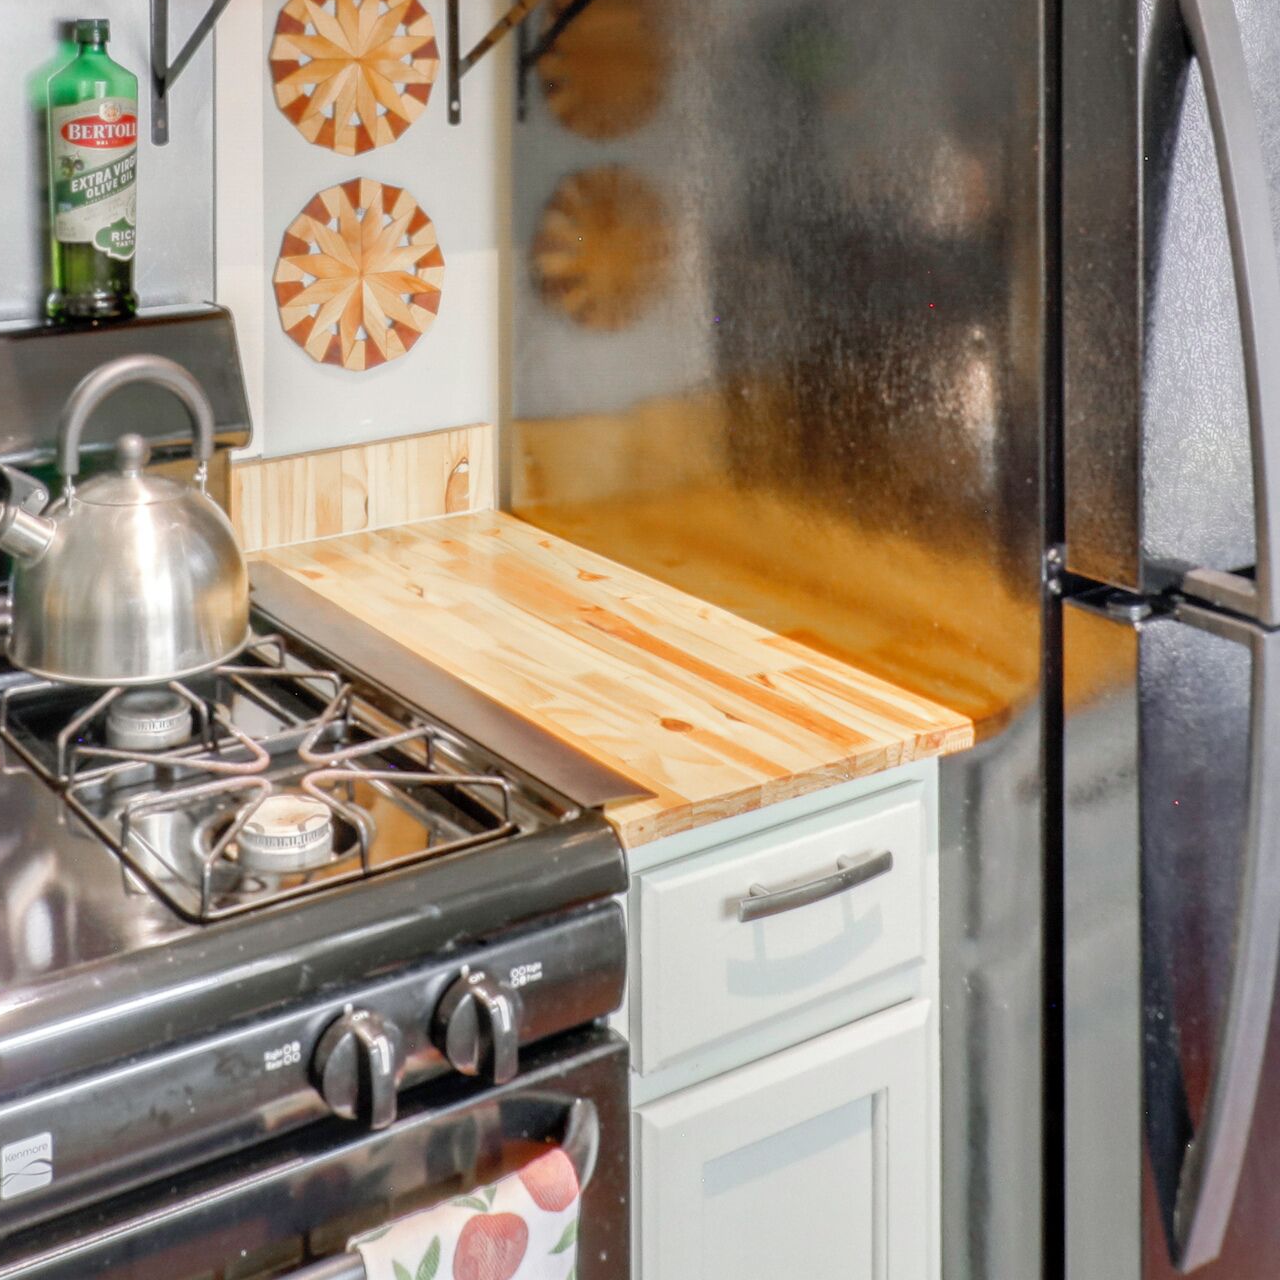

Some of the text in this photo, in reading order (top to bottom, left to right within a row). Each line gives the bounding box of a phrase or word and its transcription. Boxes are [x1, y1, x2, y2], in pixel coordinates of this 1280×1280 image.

[68, 123, 137, 140] BERTOLL
[71, 155, 136, 193] EXTRA VIRG
[86, 177, 119, 198] OLIVE
[120, 171, 133, 184] OIL
[4, 1142, 49, 1163] Kenmore
